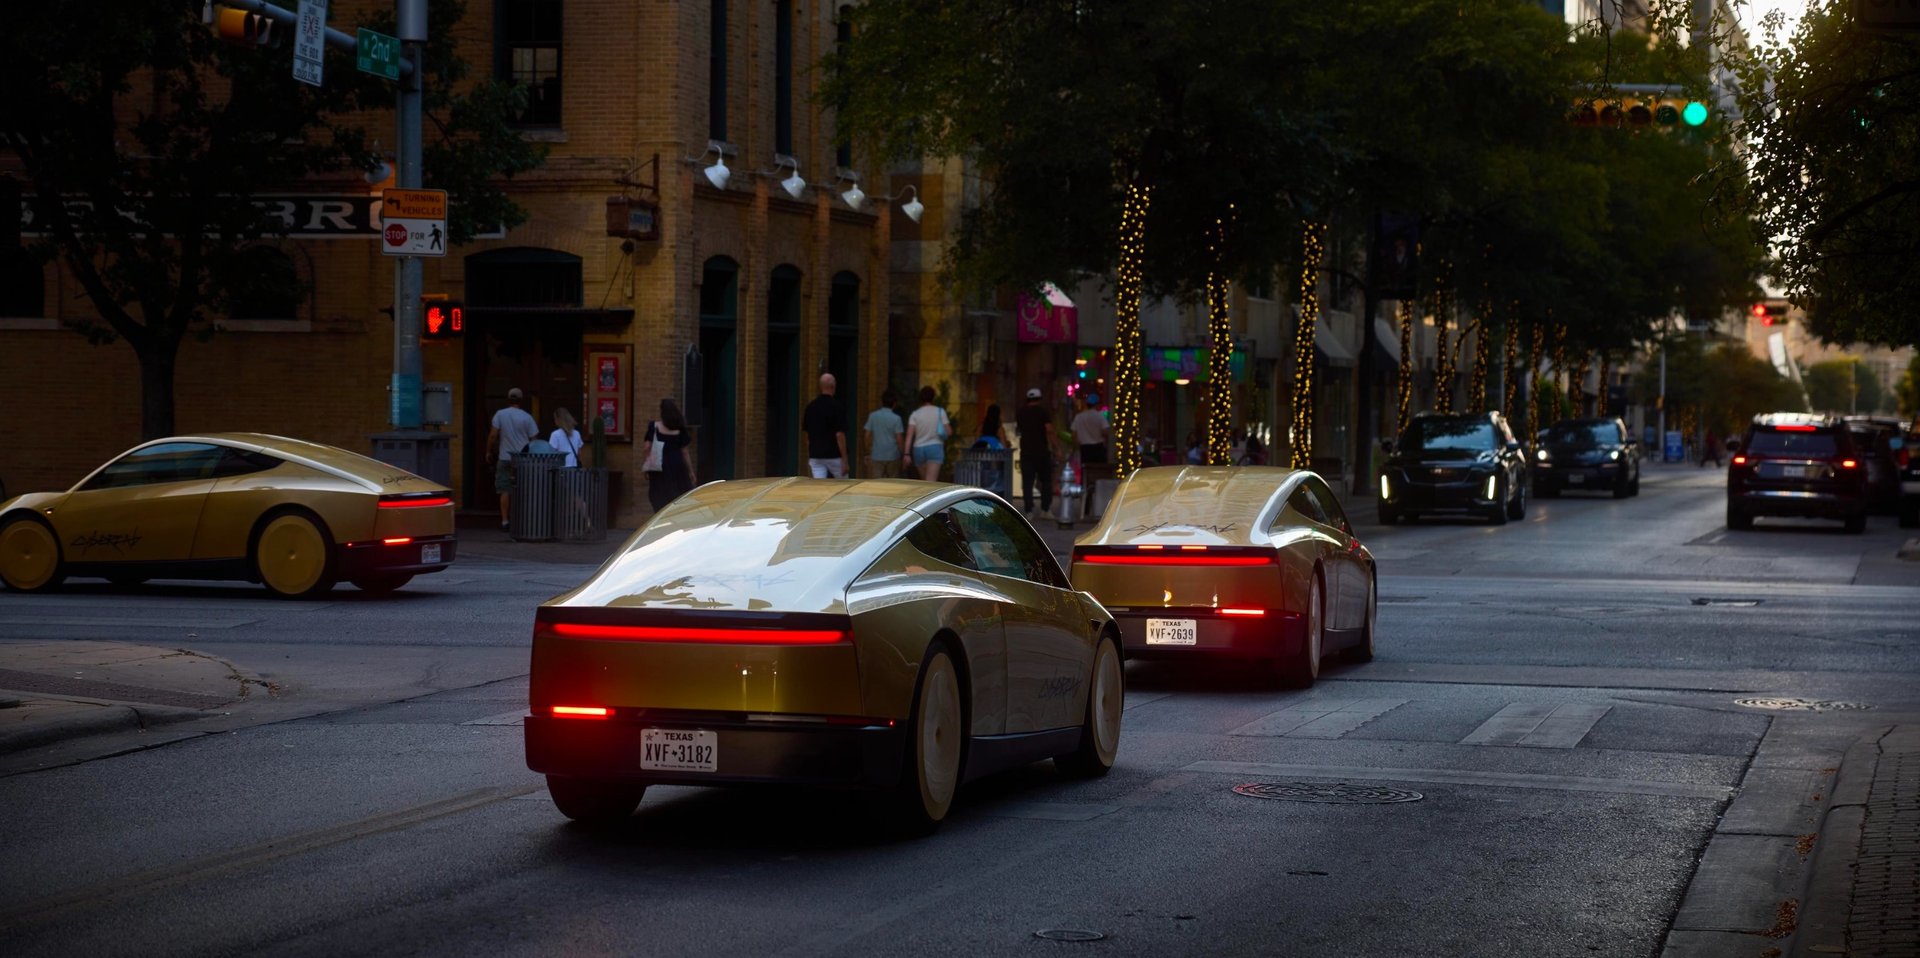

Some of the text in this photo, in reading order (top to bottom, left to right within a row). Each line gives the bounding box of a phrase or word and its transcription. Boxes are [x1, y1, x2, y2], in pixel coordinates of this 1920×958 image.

[371, 34, 390, 62] 2nd
[404, 193, 440, 203] TURNING
[402, 206, 442, 216] VEHICLES
[385, 230, 425, 241] STOP FOR
[664, 732, 694, 741] TEXAS
